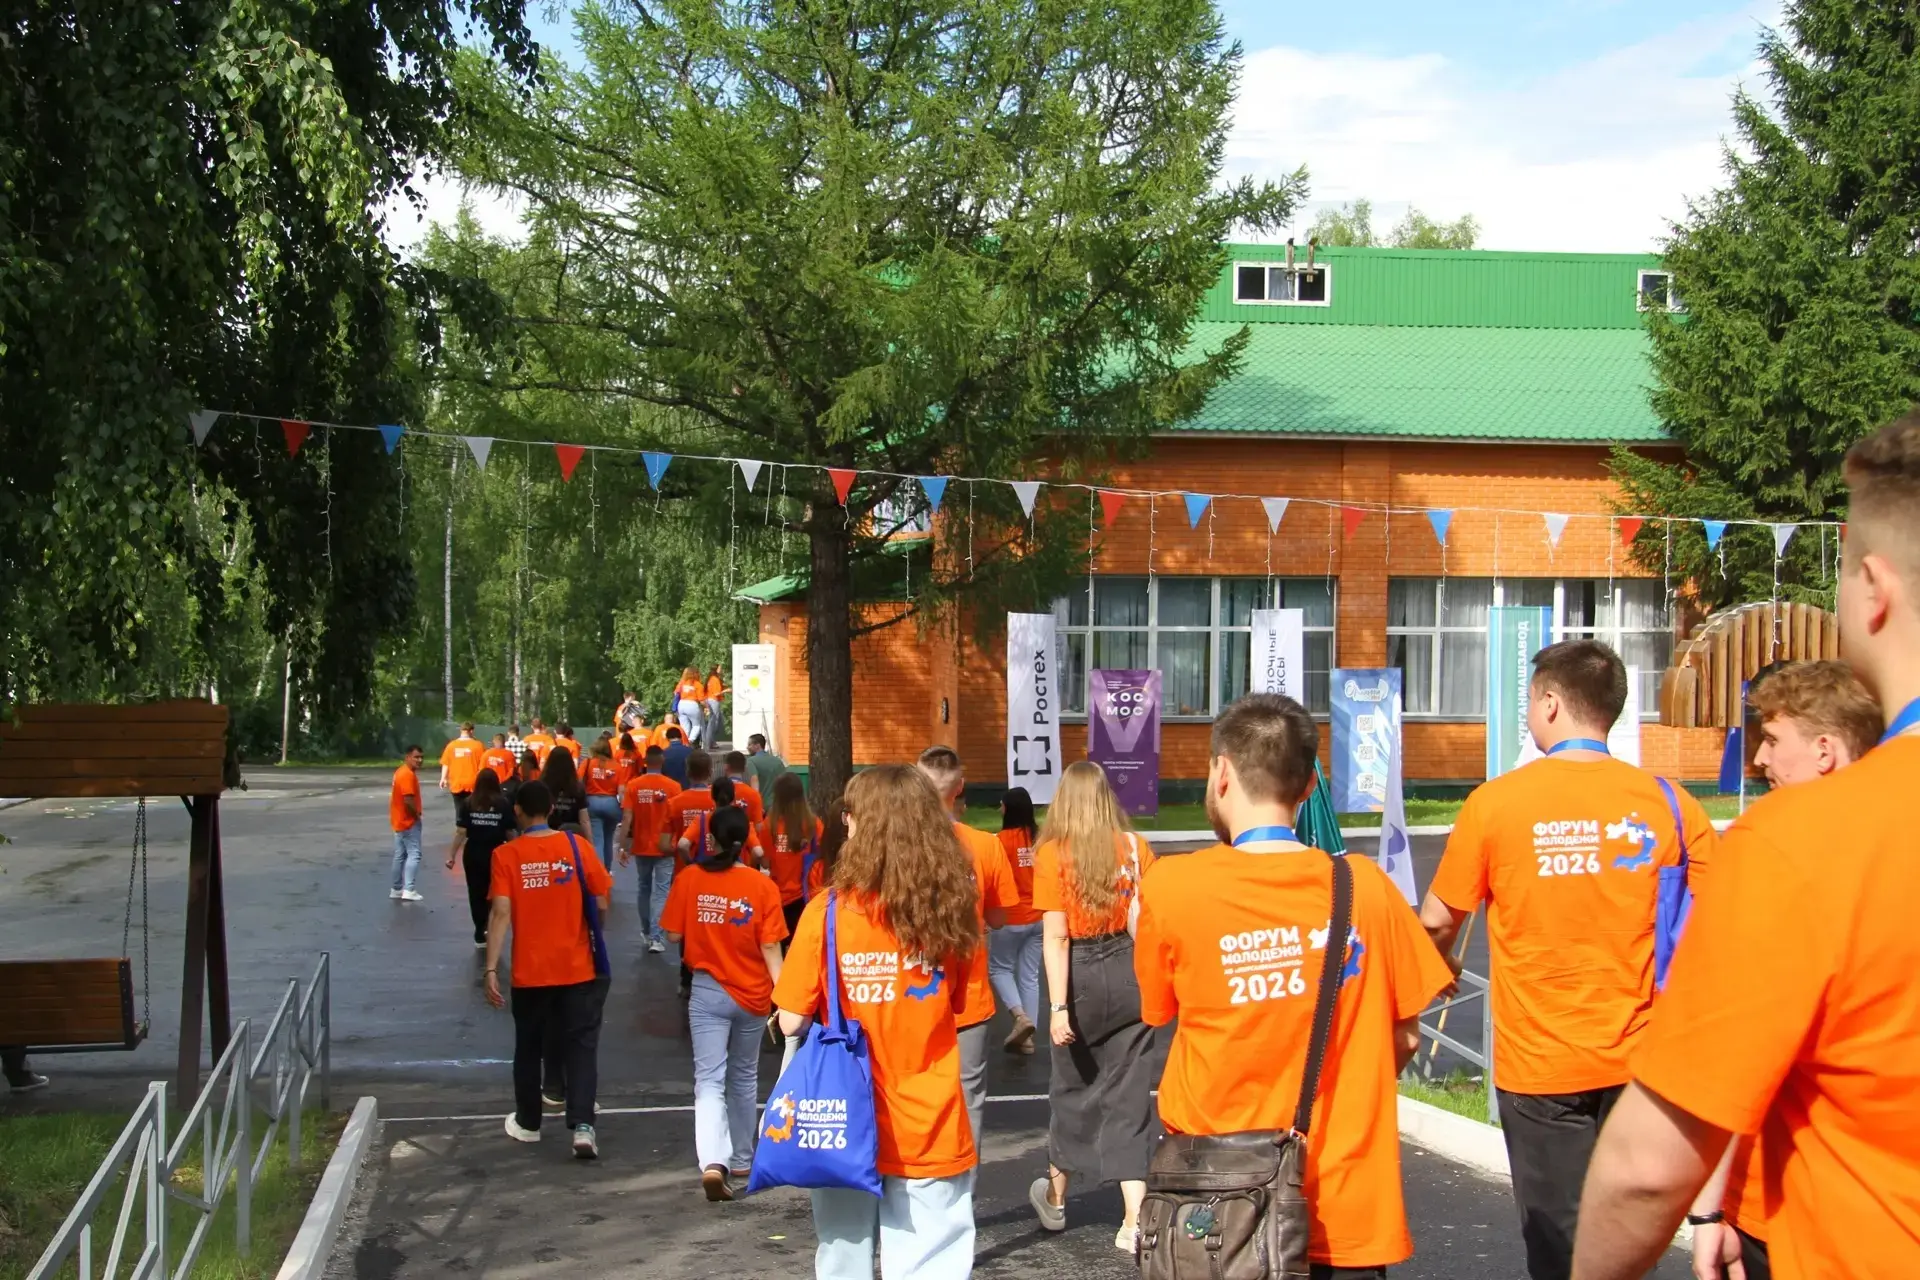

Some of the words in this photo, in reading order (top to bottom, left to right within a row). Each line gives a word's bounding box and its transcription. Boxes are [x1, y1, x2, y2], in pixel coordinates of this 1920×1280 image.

[1267, 629, 1276, 693] ОТОЧНЫЕ
[1277, 657, 1286, 694] ЕКСЫ
[1033, 650, 1049, 724] Ростех
[1107, 693, 1144, 702] КОС
[1106, 706, 1143, 716] МОС
[1532, 819, 1599, 836] ФОРУМ
[1533, 835, 1600, 846] МОЛОДЕЖИ
[521, 862, 550, 870] ФОРУМ
[1537, 853, 1600, 876] 2026
[523, 877, 550, 889] 2026
[697, 895, 728, 904] ФОРУМ
[697, 911, 724, 924] 2026
[1219, 926, 1300, 952] ФОРУМ
[841, 952, 898, 966] ФОРУМ
[1221, 945, 1303, 966] МОЛОДЕЖИ
[846, 982, 896, 1004] 2026
[1228, 968, 1306, 1004] 2026
[799, 1098, 847, 1113] ФОРУМ
[796, 1112, 848, 1123] МОЛОДЕЖИ
[798, 1128, 847, 1150] 2026
